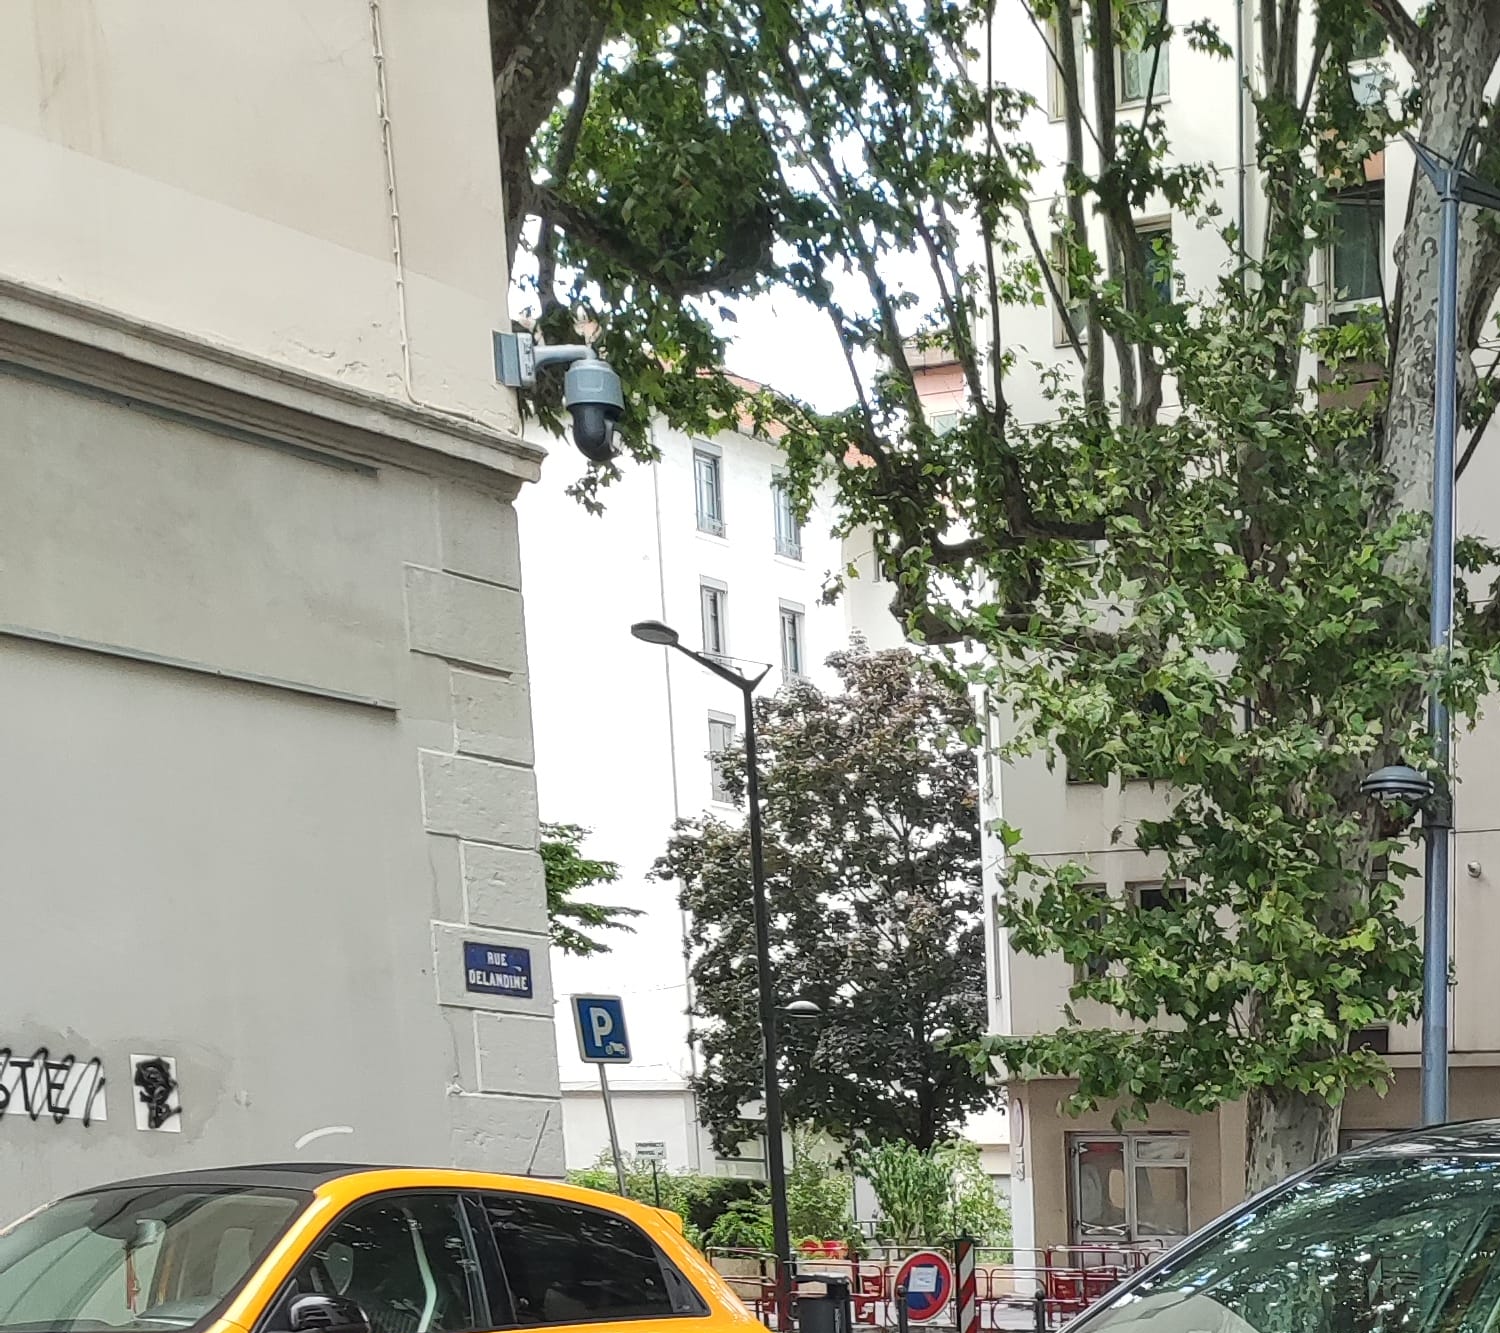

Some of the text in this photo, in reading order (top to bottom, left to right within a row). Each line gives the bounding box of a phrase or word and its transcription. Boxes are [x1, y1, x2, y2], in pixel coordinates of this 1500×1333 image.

[487, 952, 508, 966] RUE
[468, 969, 528, 990] DELANDINE
[589, 1006, 613, 1047] P
